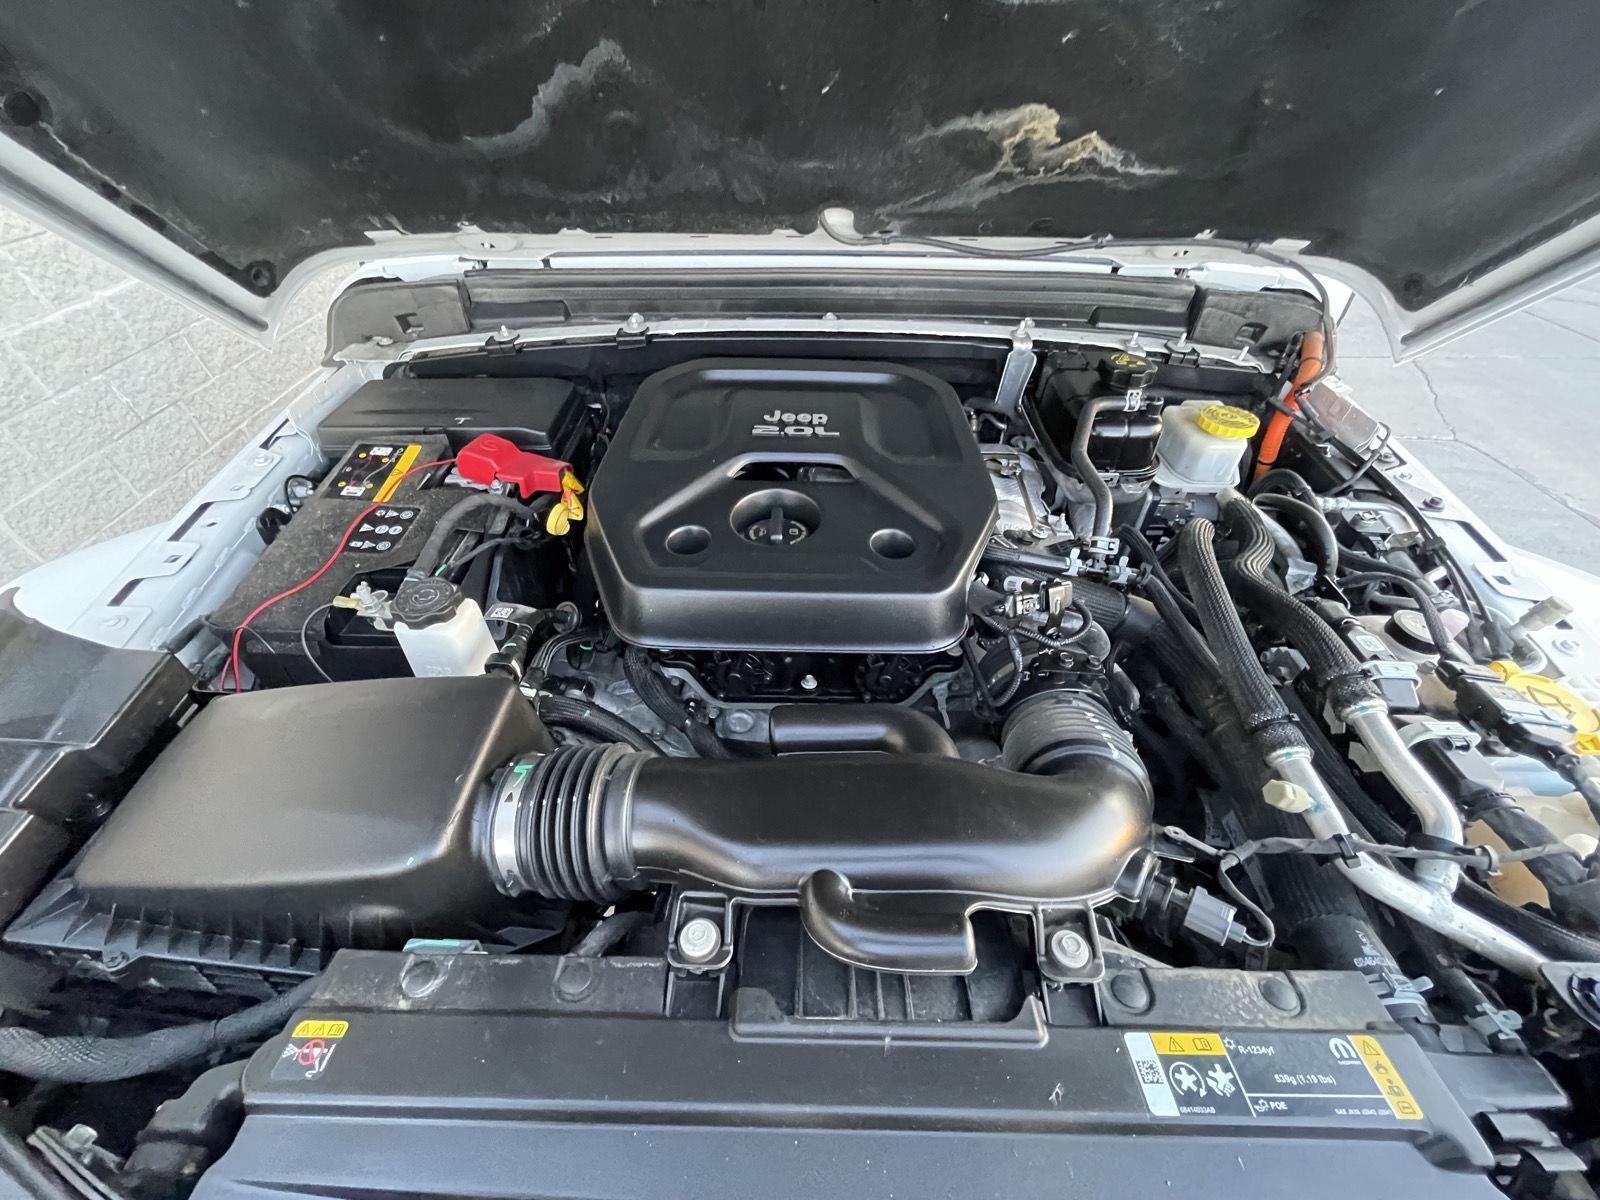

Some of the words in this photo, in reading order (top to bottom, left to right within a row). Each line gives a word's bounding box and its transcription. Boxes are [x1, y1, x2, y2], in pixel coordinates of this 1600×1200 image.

[763, 410, 828, 424] Jeep
[752, 425, 840, 436] 2.0L
[1269, 1101, 1288, 1110] POE
